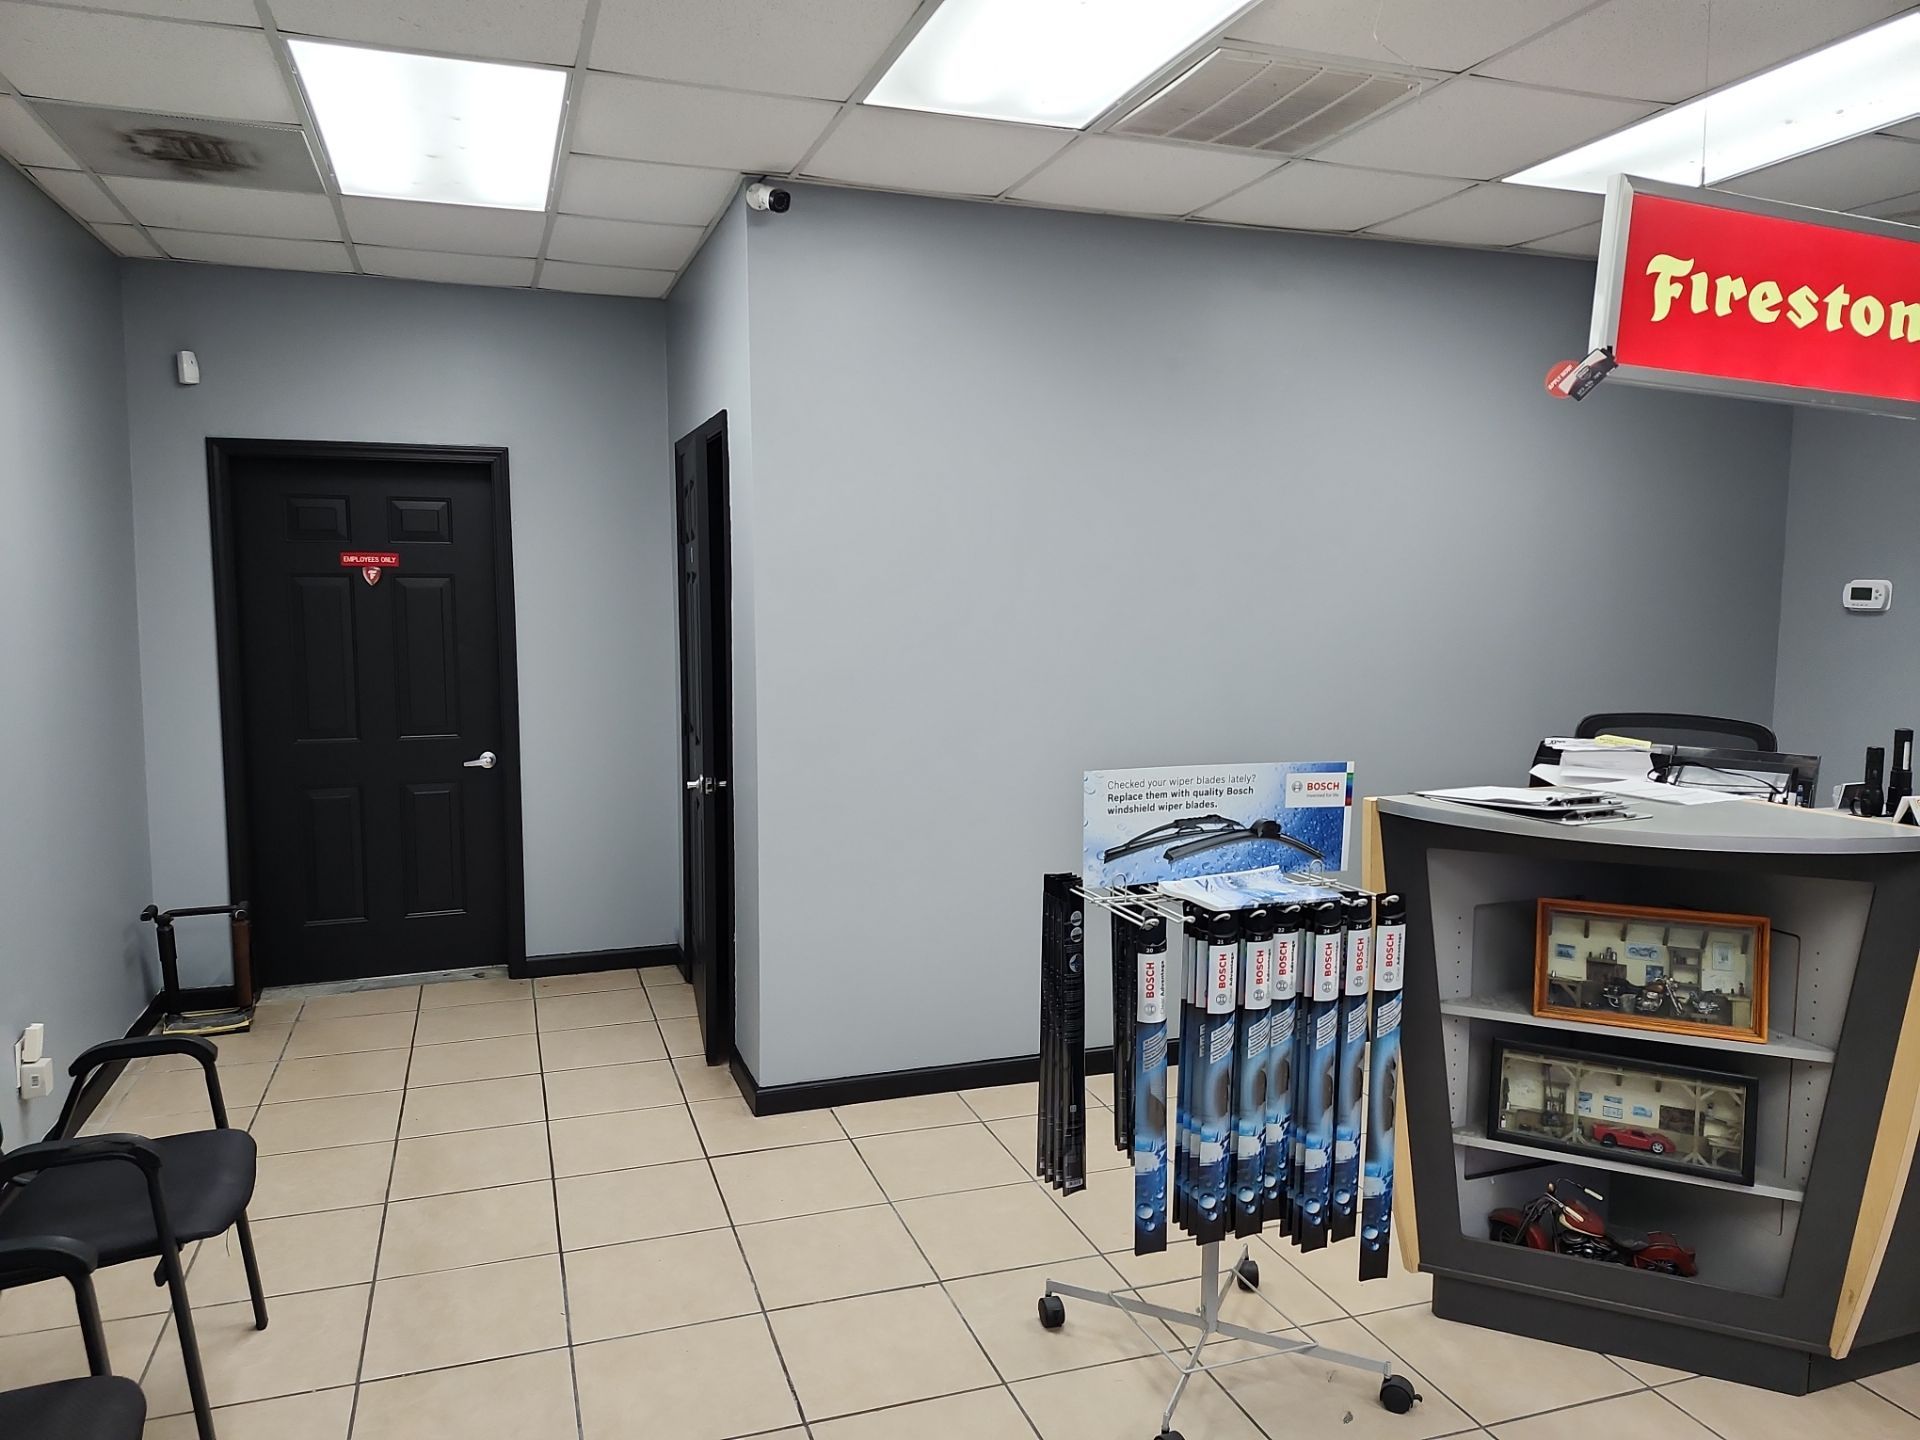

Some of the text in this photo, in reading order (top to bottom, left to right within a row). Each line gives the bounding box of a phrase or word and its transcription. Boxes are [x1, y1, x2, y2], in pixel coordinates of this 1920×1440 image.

[343, 555, 379, 563] EMPLOYEES
[1107, 773, 1257, 790] Checked your wiper blades lately?
[1107, 786, 1254, 804] Replace them with quality Bosch
[1306, 781, 1340, 791] BOSCH
[1107, 799, 1218, 815] windshield wiper blades.
[1279, 941, 1288, 976] BOSCH
[1324, 942, 1333, 977] BOSCH
[1356, 937, 1364, 972] BOSCH
[1386, 933, 1394, 967] BOSCH
[1146, 962, 1155, 999] BOSCH
[1218, 953, 1227, 989] BOSCH
[1255, 950, 1264, 985] BOSCH
